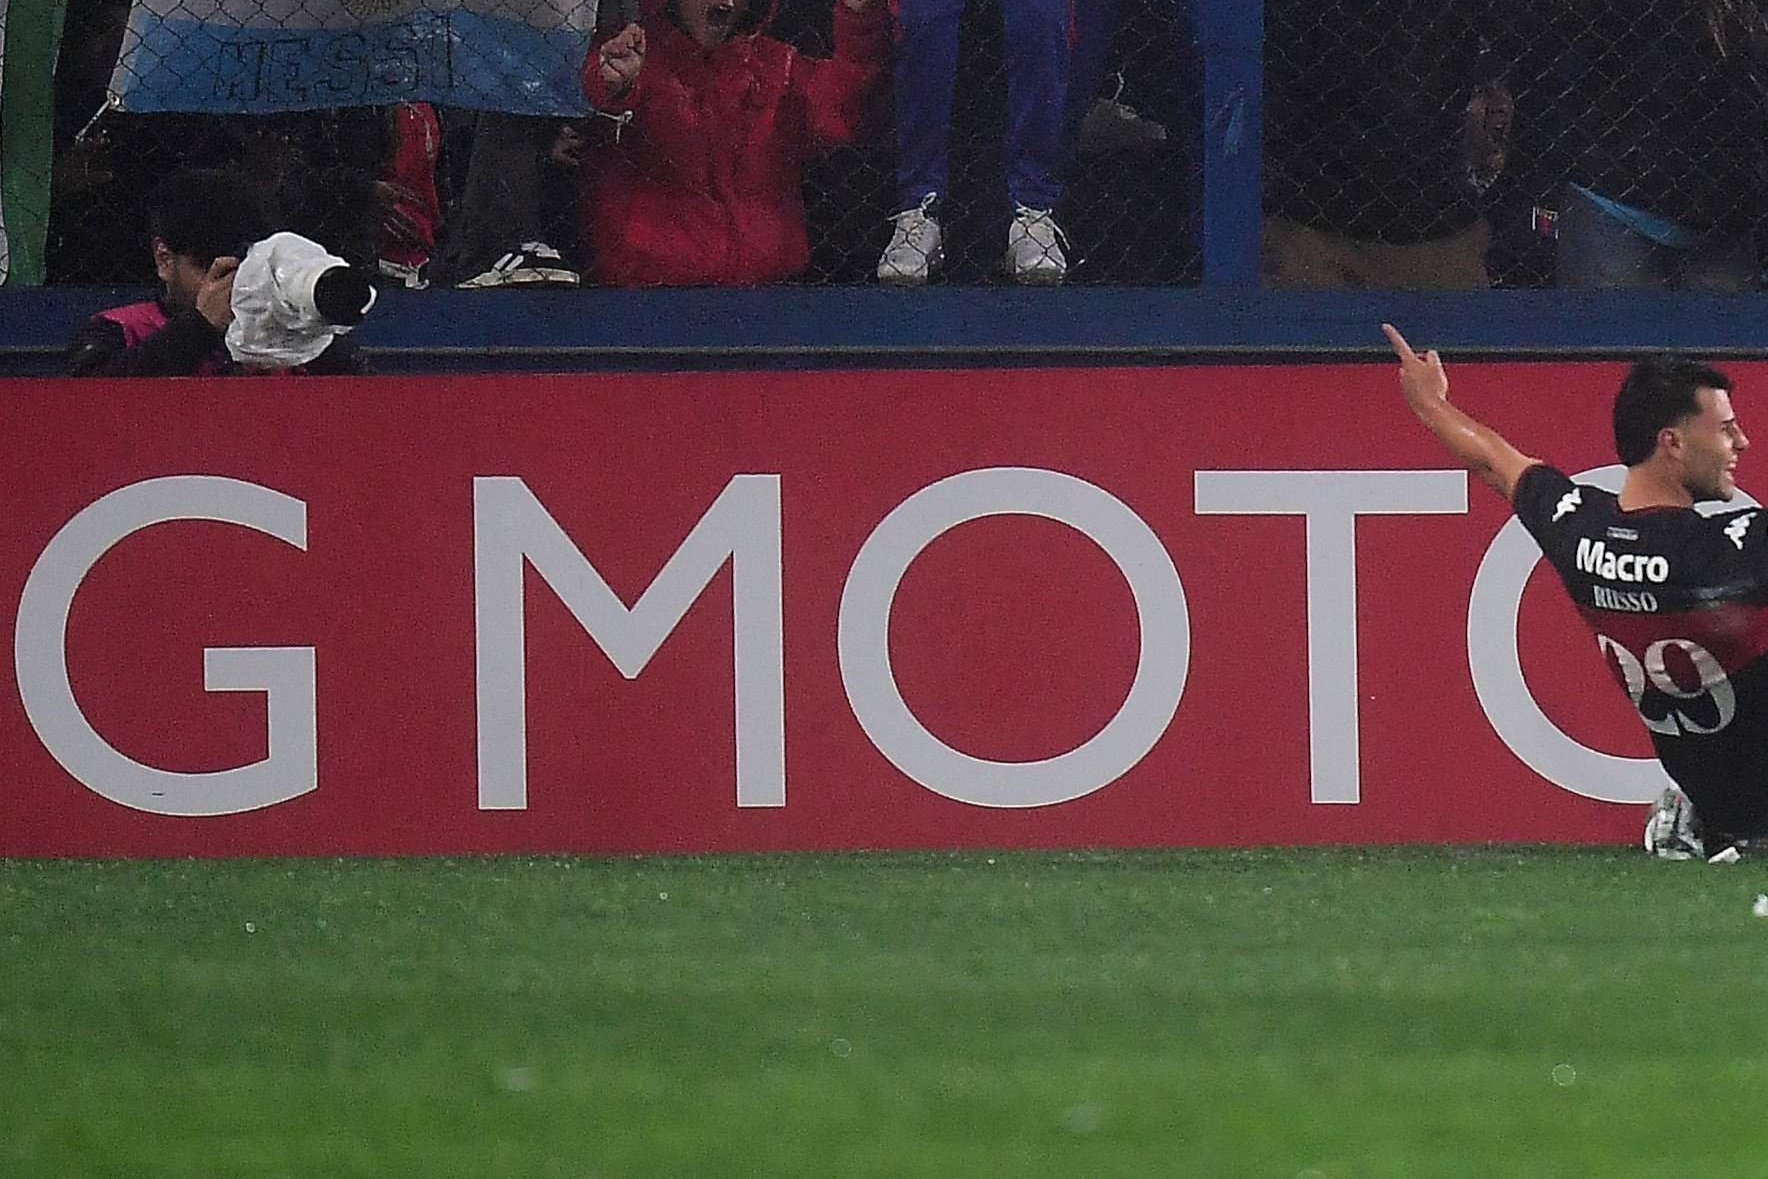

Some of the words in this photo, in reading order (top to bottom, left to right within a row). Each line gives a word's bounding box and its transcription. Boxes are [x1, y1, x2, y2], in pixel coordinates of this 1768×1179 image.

[1575, 536, 1671, 583] Macro
[1592, 584, 1660, 613] RUSSO
[14, 474, 320, 817] G
